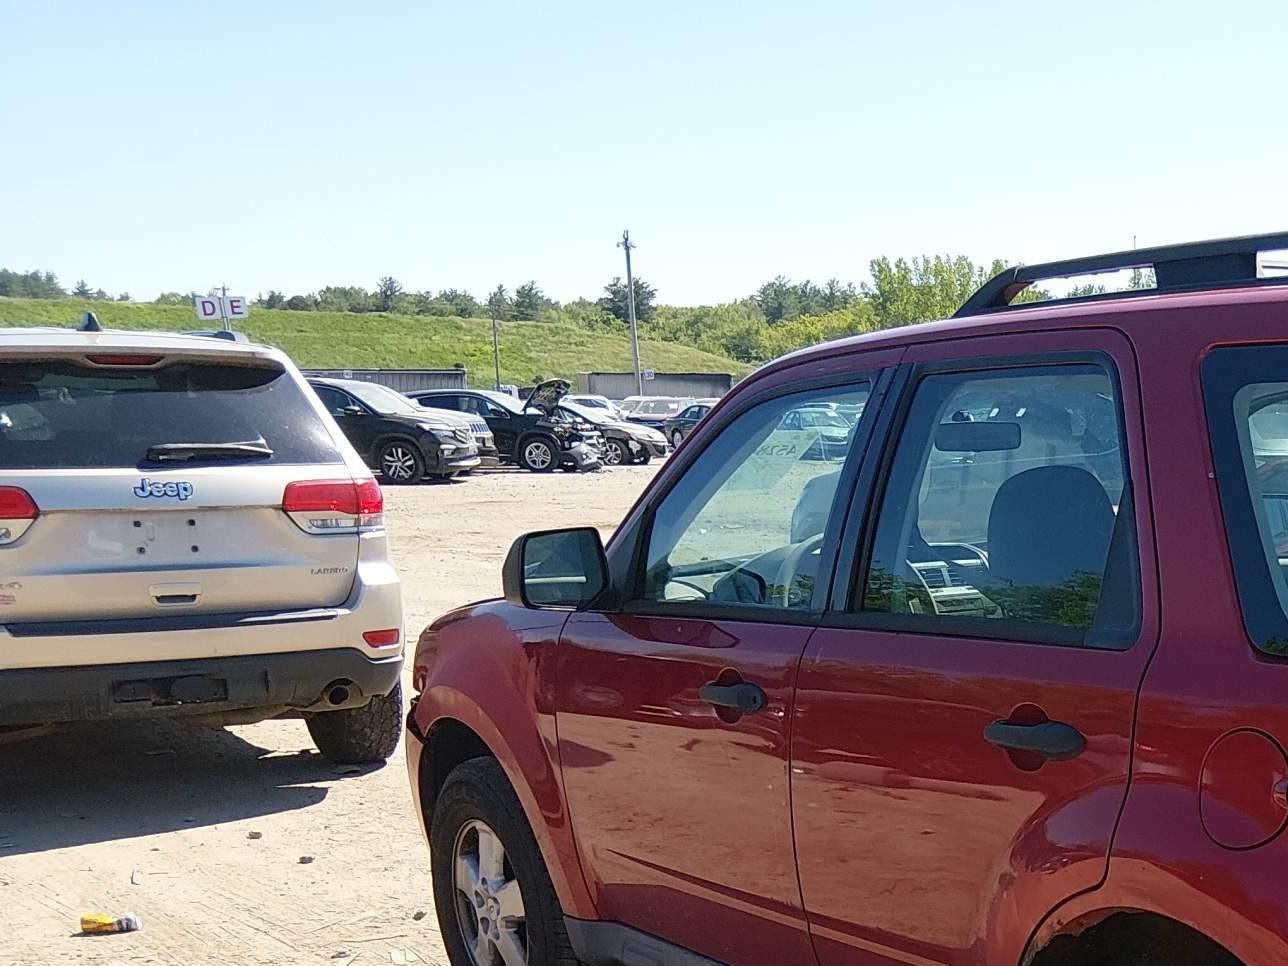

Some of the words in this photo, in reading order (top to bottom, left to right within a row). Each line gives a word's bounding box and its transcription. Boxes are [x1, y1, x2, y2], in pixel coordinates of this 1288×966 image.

[201, 300, 216, 316] D
[229, 299, 244, 316] E
[133, 478, 194, 501] Jeep
